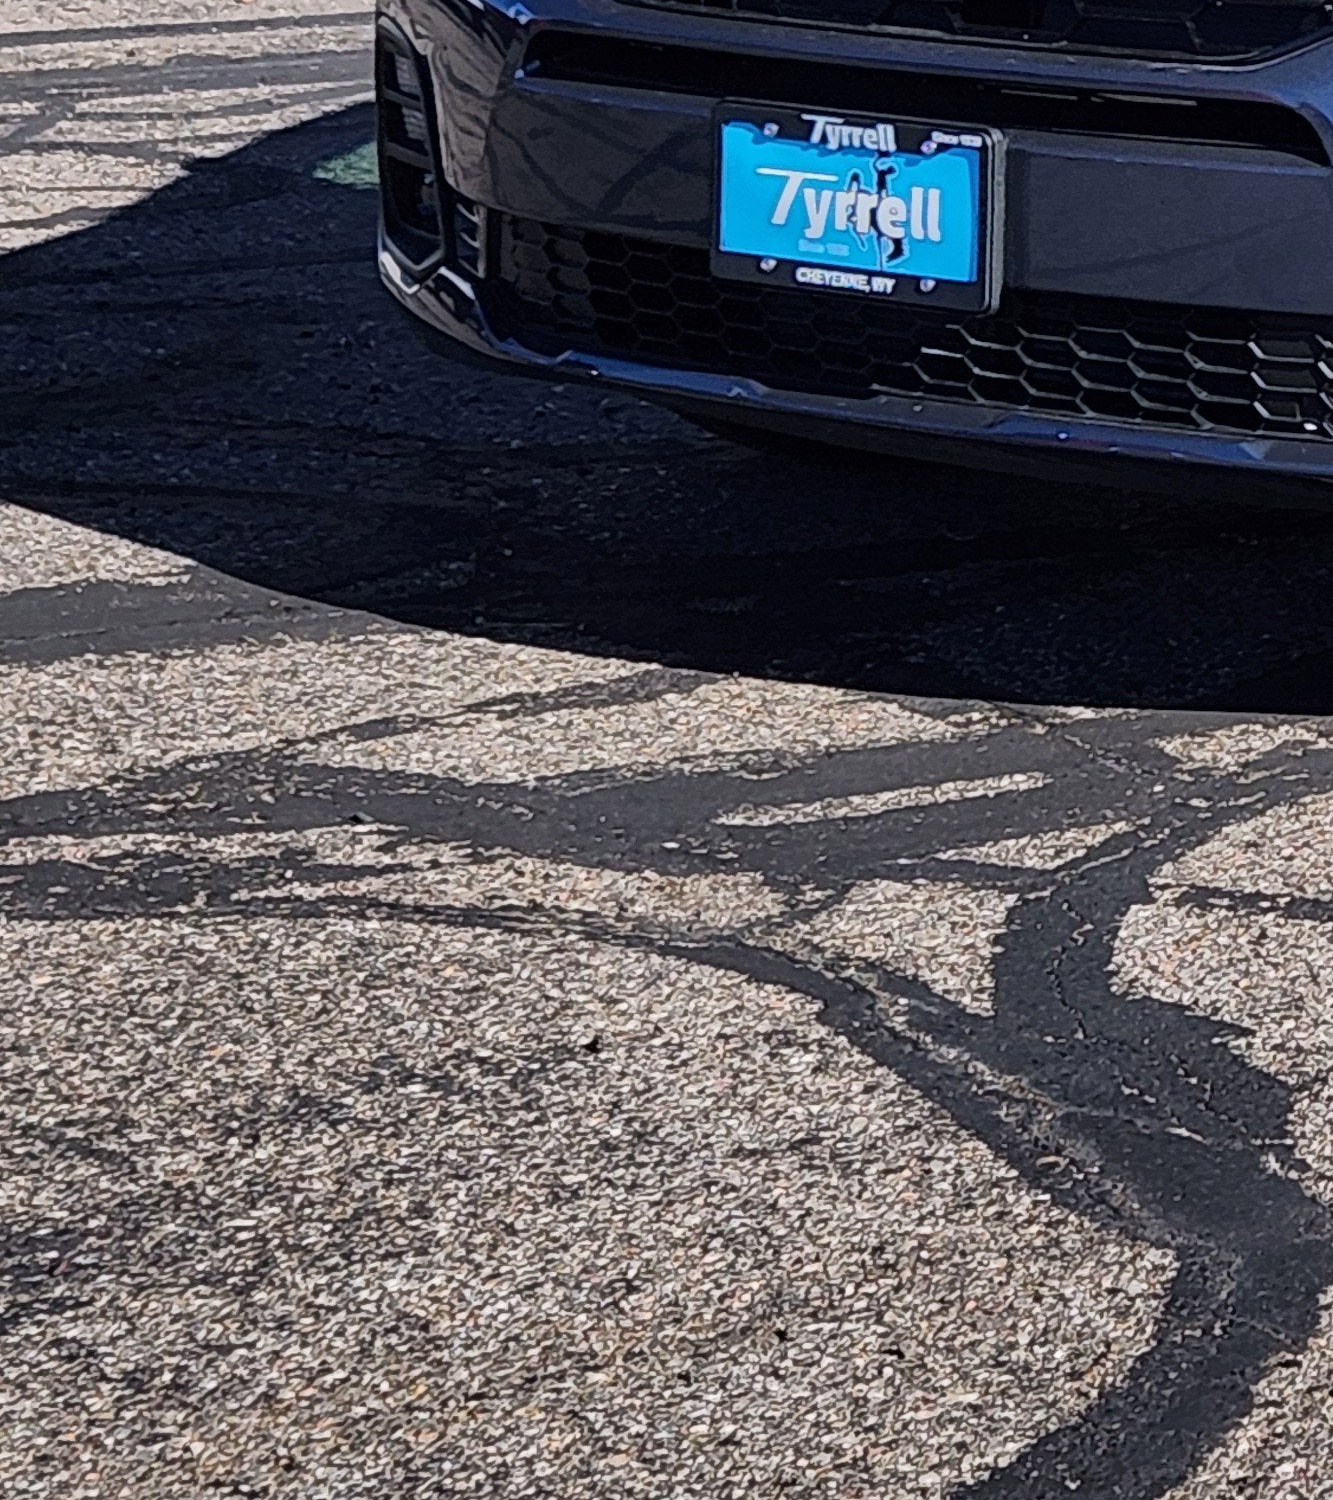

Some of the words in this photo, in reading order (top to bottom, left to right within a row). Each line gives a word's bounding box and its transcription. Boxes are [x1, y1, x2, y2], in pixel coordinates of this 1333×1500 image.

[801, 113, 897, 151] Tyrrell
[755, 167, 941, 242] Tyrrell
[871, 276, 896, 294] WY
